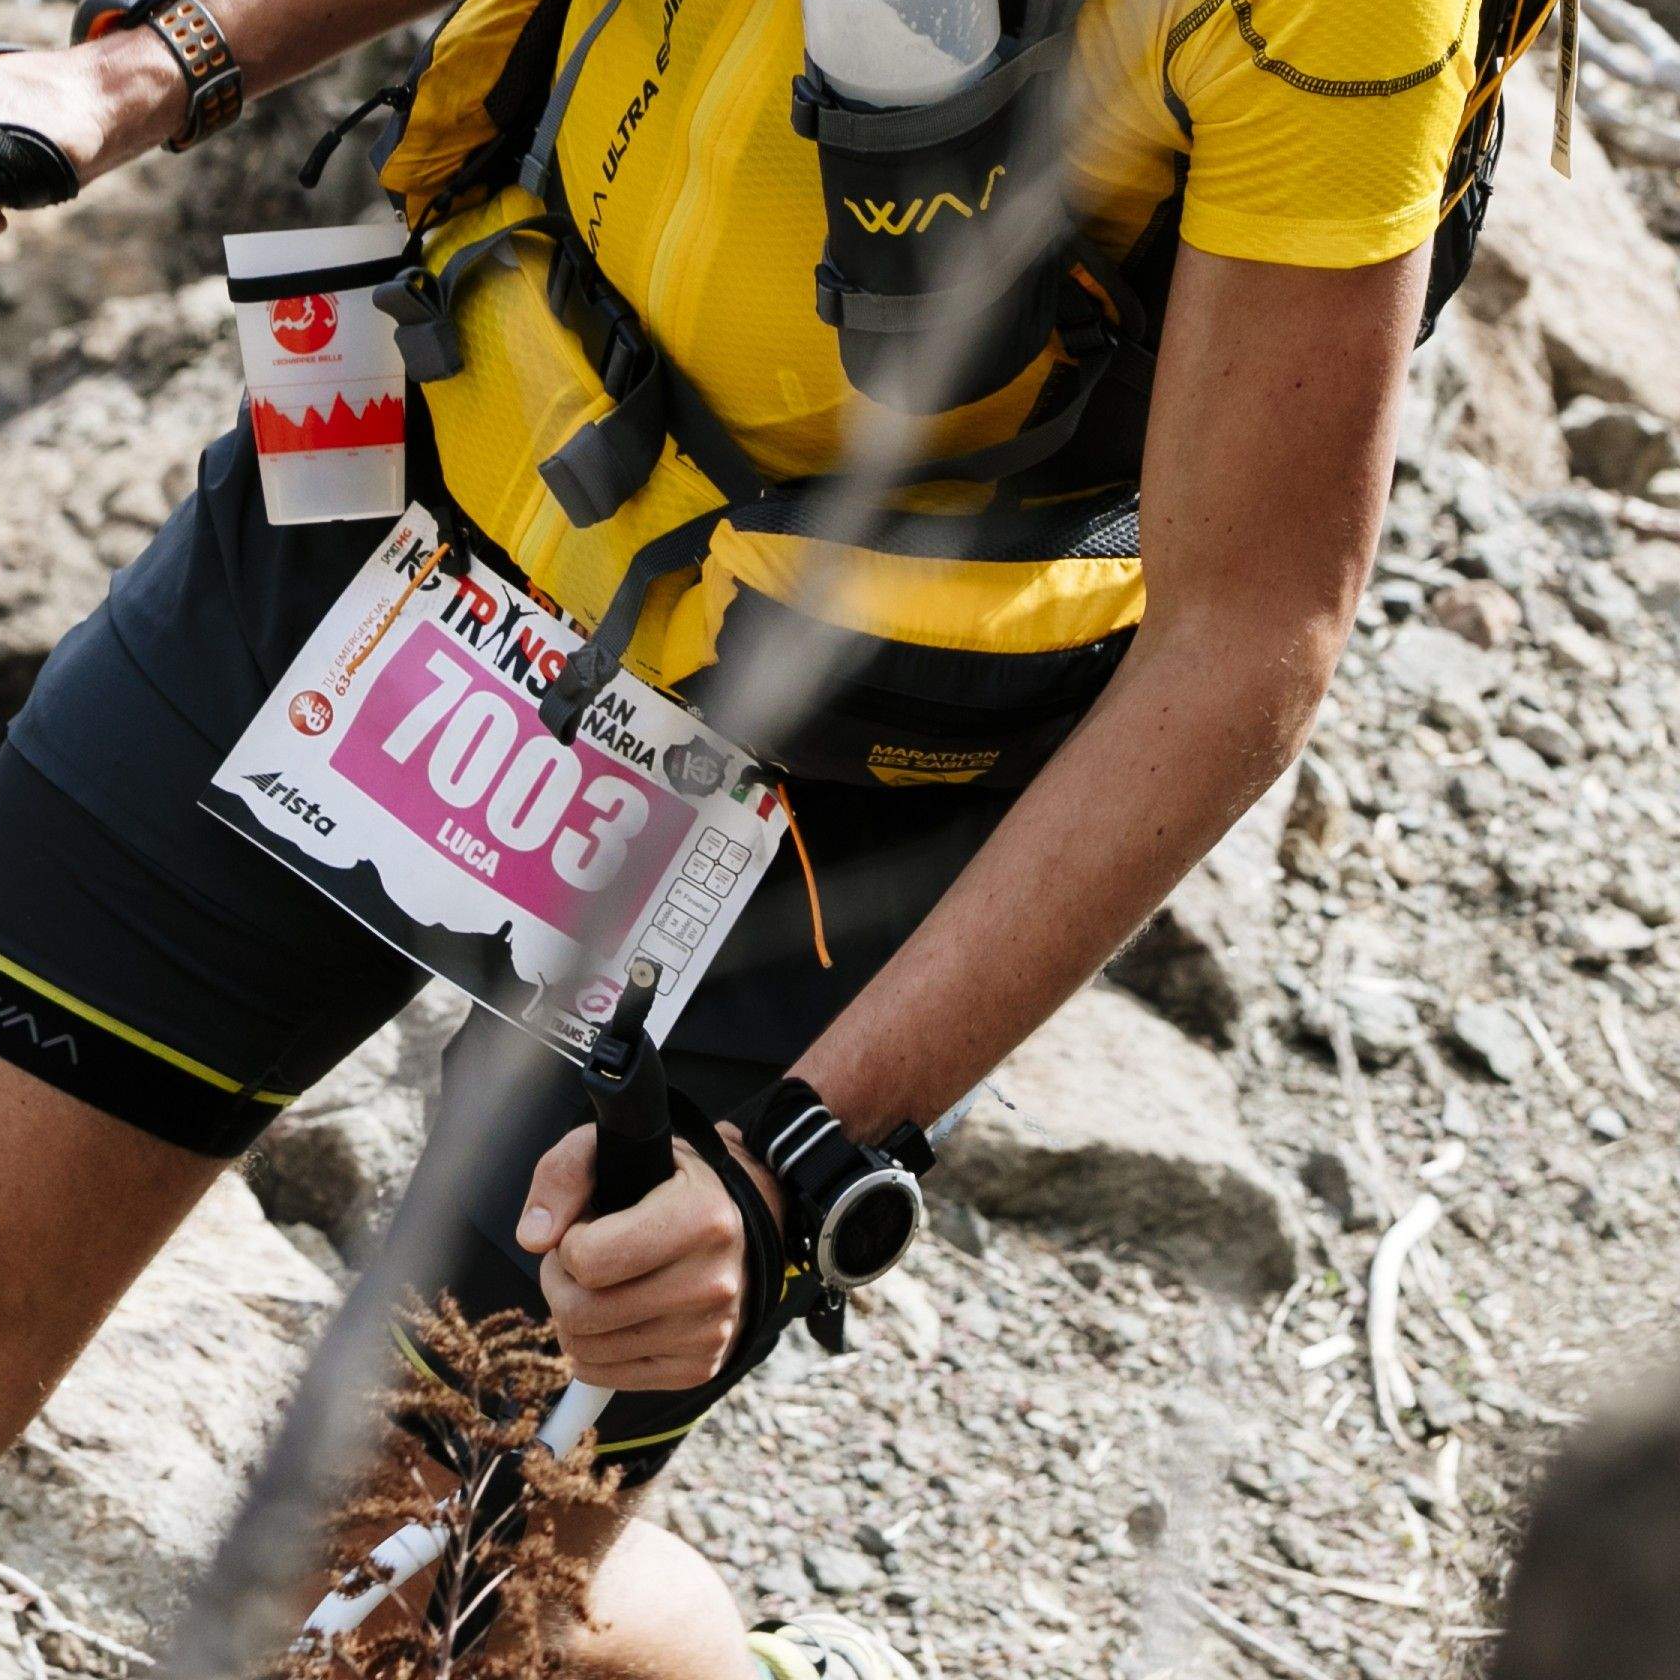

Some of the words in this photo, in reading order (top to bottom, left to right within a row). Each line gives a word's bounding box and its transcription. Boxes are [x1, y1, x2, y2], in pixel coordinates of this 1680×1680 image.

[602, 79, 659, 183] ULTRA
[594, 691, 637, 728] AN
[381, 648, 651, 894] 7003
[581, 710, 657, 772] NARIA
[872, 744, 1001, 761] MARATHON
[239, 771, 338, 837] Arista
[436, 818, 503, 880] LUCA
